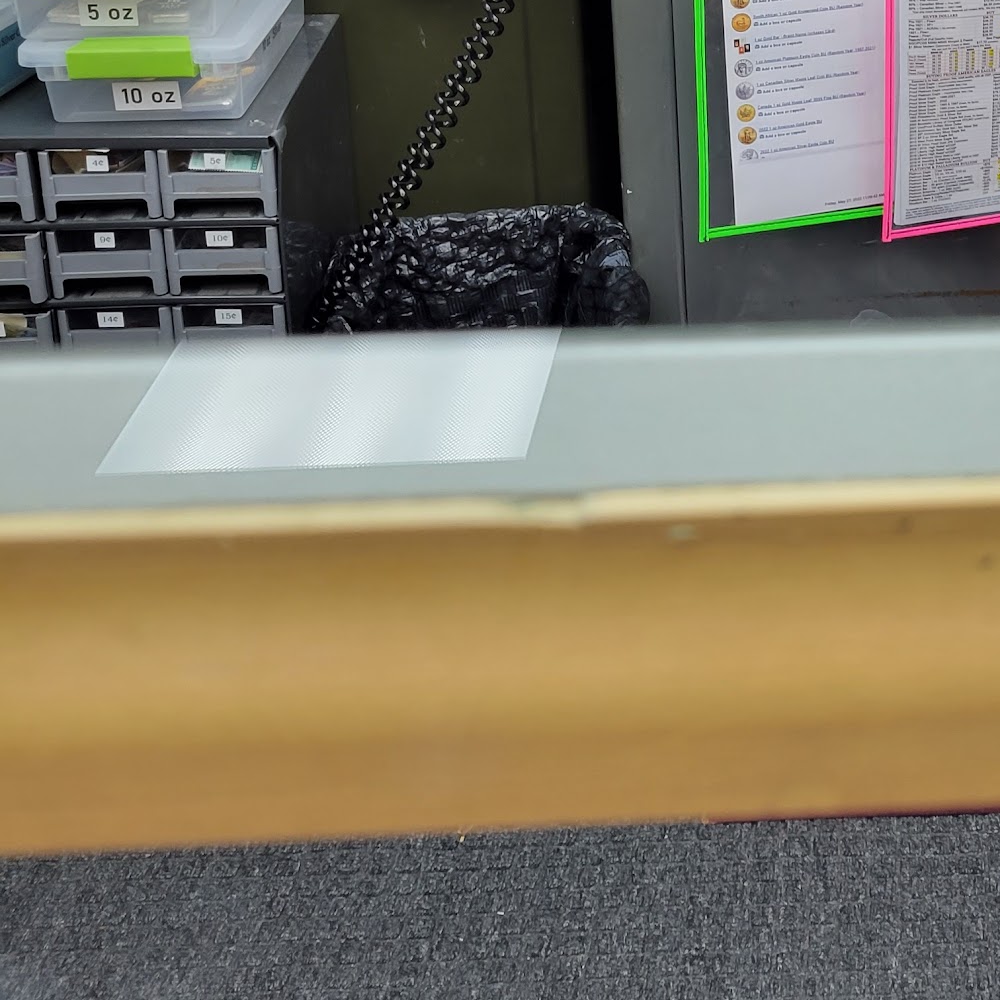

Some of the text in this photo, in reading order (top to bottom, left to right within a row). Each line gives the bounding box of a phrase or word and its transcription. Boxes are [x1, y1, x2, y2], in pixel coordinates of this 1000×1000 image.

[88, 4, 134, 20] 5 oz
[122, 88, 176, 104] 10 oz
[92, 159, 104, 167] 4¢
[100, 236, 111, 244] 9¢
[103, 316, 118, 324] 14¢
[220, 312, 236, 320] 15¢
